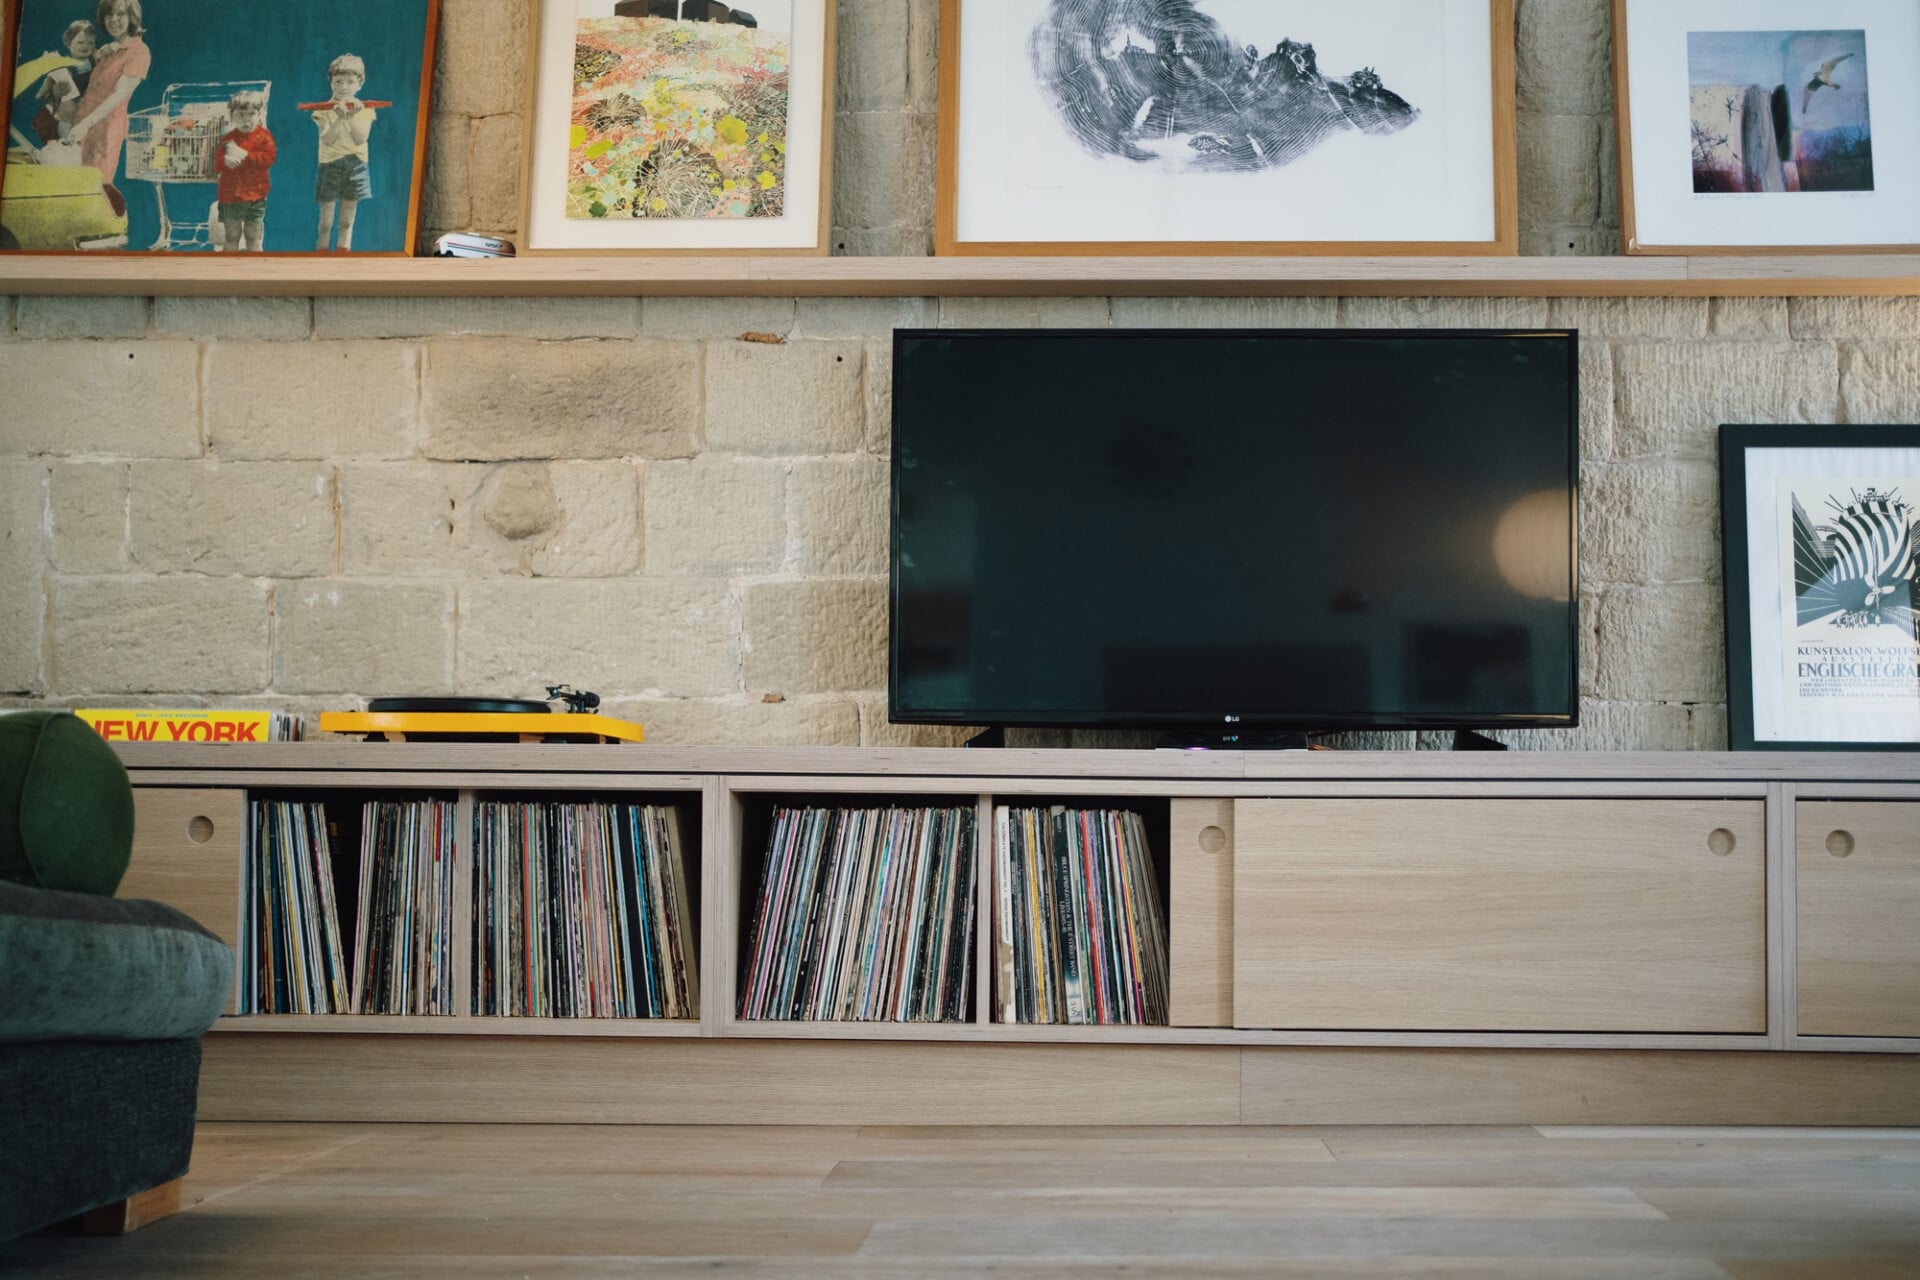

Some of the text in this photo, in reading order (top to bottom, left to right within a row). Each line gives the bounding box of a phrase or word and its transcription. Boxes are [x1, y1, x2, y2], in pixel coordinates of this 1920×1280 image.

[1797, 646, 1920, 656] KUNSTSALON WOLFS
[1798, 662, 1920, 678] ENGLISCHE GRA
[166, 721, 261, 742] YORK
